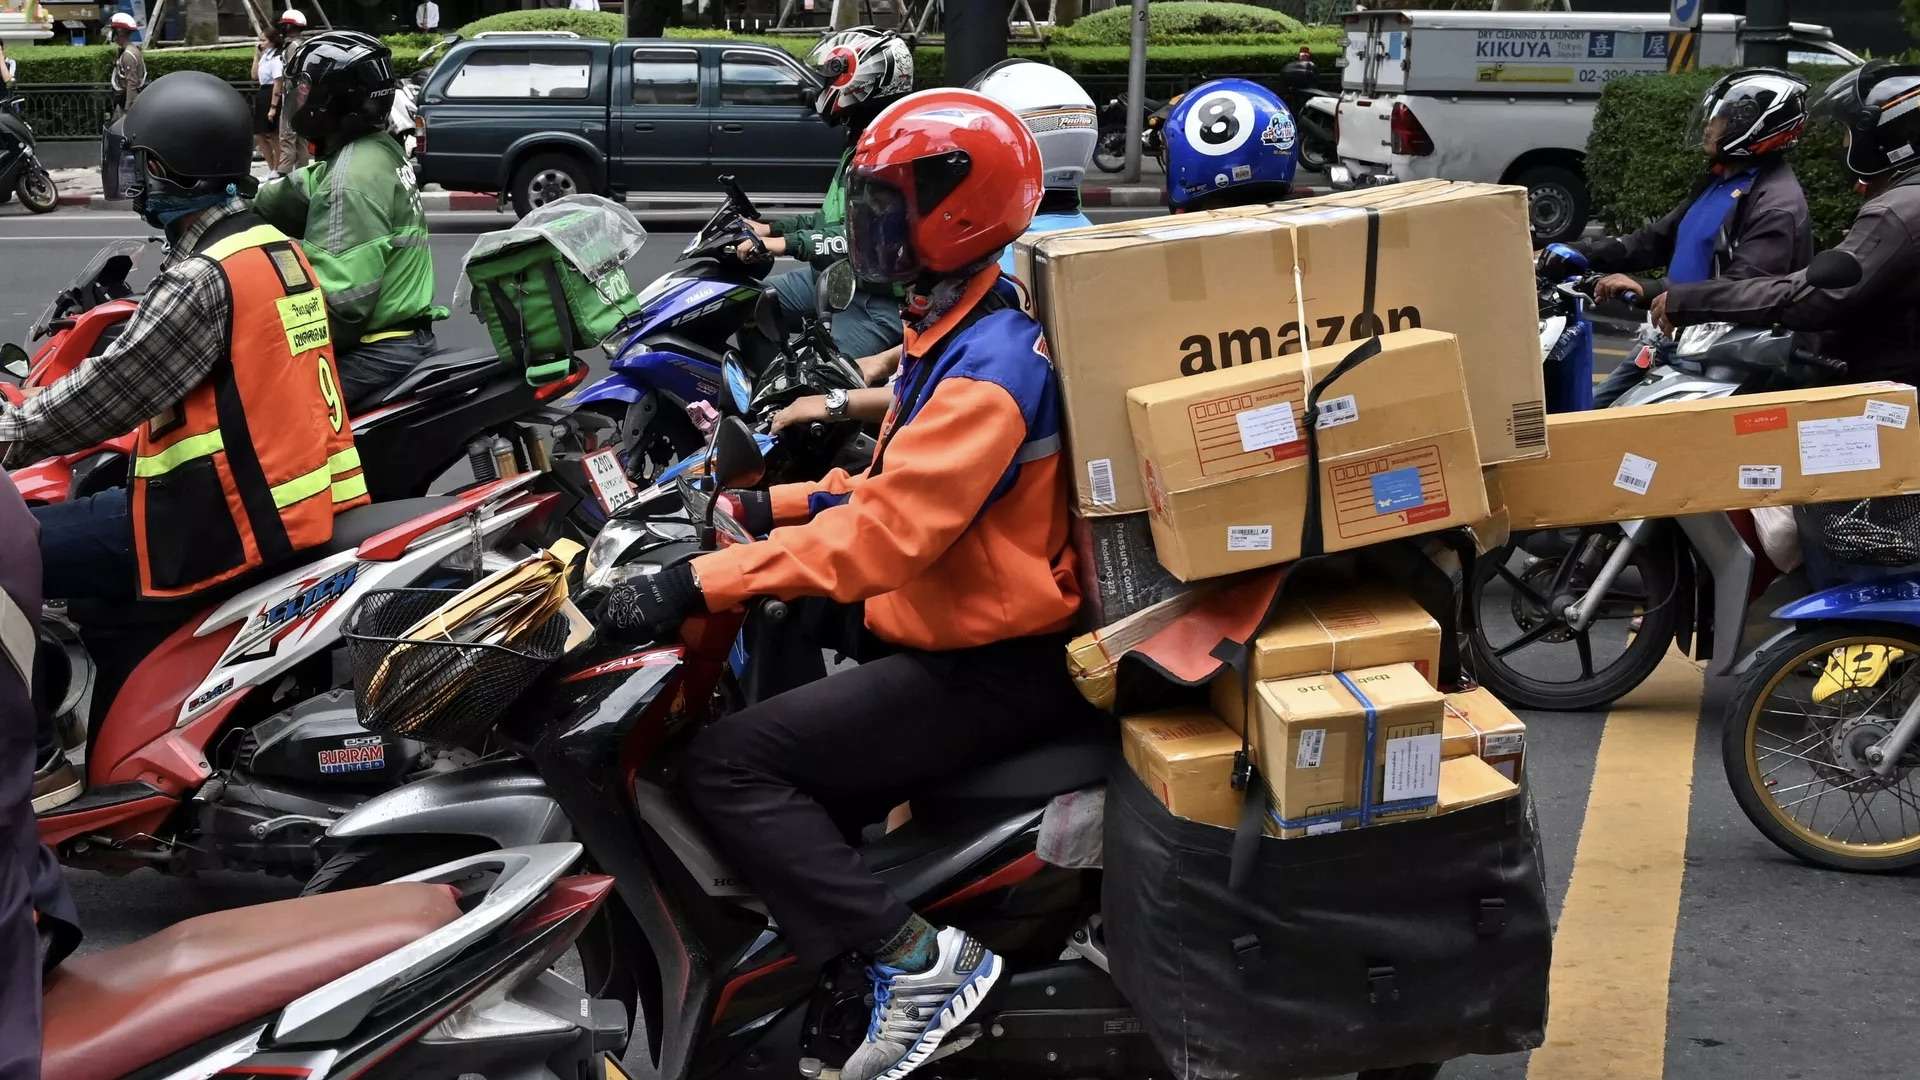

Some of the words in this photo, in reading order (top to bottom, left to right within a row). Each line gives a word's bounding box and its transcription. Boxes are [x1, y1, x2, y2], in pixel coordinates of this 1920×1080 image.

[1138, 10, 1145, 21] 2
[1478, 31, 1492, 39] DRY
[1496, 31, 1536, 39] CLEANING
[1540, 31, 1546, 39] &
[1550, 31, 1585, 39] LAUNDRY
[1589, 33, 1612, 56] 喜
[1645, 33, 1668, 56] 屋
[1476, 41, 1551, 57] KIKUYA
[1198, 97, 1240, 145] 8
[811, 230, 848, 255] Gra
[1178, 304, 1422, 377] amazon
[318, 354, 344, 433] 9
[1115, 522, 1129, 568] Pressure
[1122, 568, 1135, 605] Cooker
[318, 745, 385, 765] BURIRAM
[320, 760, 385, 774] UNITED
